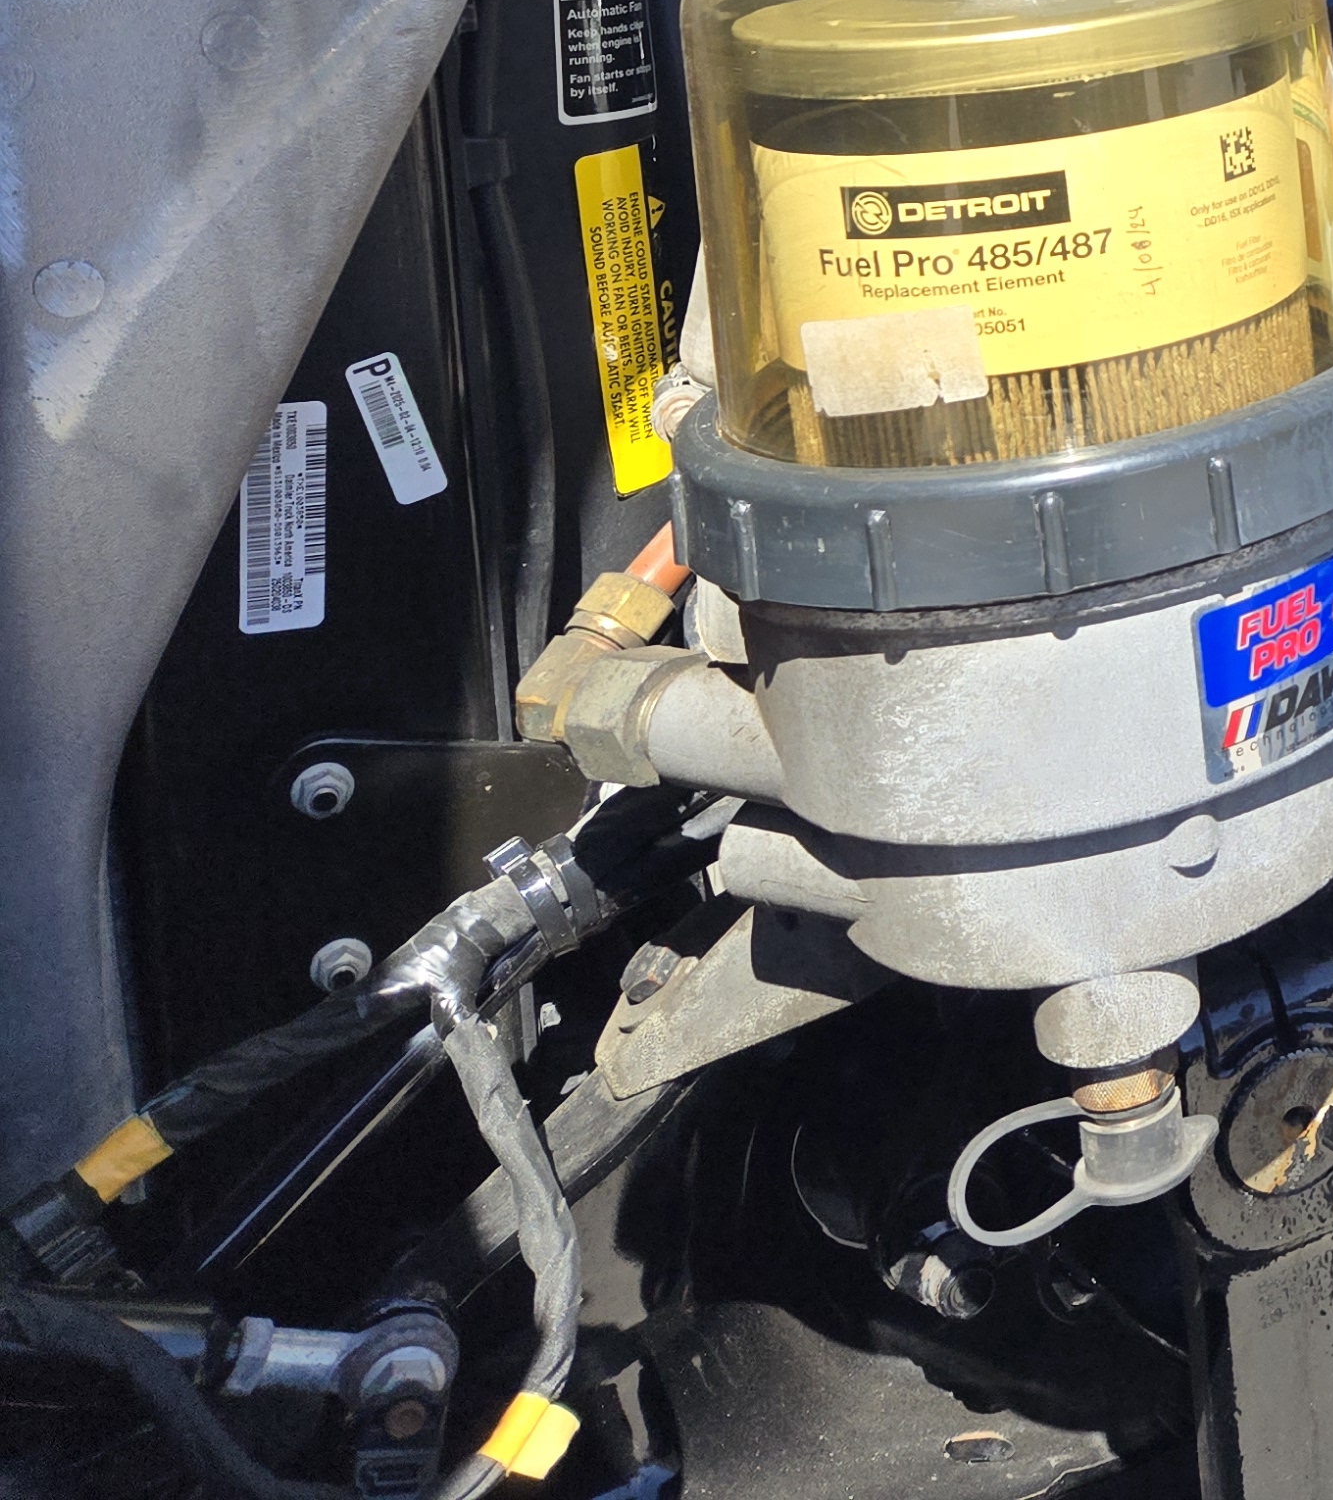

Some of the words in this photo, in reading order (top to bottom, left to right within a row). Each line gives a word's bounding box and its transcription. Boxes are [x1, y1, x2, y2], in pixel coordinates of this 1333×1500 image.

[567, 3, 627, 21] Automatic
[629, 2, 642, 14] Fan
[568, 27, 598, 39] Keep
[600, 24, 628, 36] hands
[568, 41, 599, 52] when
[602, 36, 632, 49] engine
[633, 34, 641, 45] is
[569, 53, 615, 66] running.
[570, 73, 591, 85] Fan
[594, 69, 624, 82] starts
[625, 67, 634, 77] or
[570, 87, 585, 99] by
[588, 82, 618, 95] itself.
[617, 196, 629, 235] AVOID
[629, 191, 642, 238] ENGINE
[898, 188, 1052, 223] DETROIT
[1190, 206, 1210, 216] Only
[1212, 200, 1223, 210] for
[1225, 197, 1237, 206] use
[1239, 192, 1247, 200] on
[1243, 193, 1276, 215] applications
[602, 199, 619, 261] WORKING
[590, 226, 605, 269] SOUND
[622, 236, 634, 282] INJURY,
[635, 240, 648, 280] COULD
[818, 248, 881, 278] Fuel
[893, 249, 954, 278] Pro
[968, 228, 1113, 272] 485/487
[610, 263, 622, 282] ON
[862, 282, 981, 301] Replacement
[986, 269, 1066, 292] Element
[595, 270, 612, 318] BEFORE
[614, 284, 626, 311] FAN
[627, 284, 639, 317] TURN
[640, 283, 652, 317] START
[617, 314, 628, 332] OR
[660, 279, 676, 371] CAUTI
[988, 307, 1007, 318] No.
[619, 334, 633, 371] BELTS.
[631, 318, 646, 373] IGNITION
[644, 320, 659, 389] AUTOMATIC
[352, 358, 392, 378] P
[624, 374, 636, 416] ALARM
[638, 376, 648, 398] OFF
[274, 411, 283, 429] Made
[610, 387, 626, 429] START.
[641, 400, 653, 439] WHEN
[628, 417, 641, 444] WILL
[272, 437, 281, 464] Mexico
[284, 474, 295, 498] Daimler
[284, 500, 294, 521] Truck
[284, 522, 294, 540] North
[284, 541, 293, 568] America
[1237, 583, 1322, 651] FUEL
[1249, 620, 1322, 681] PRO
